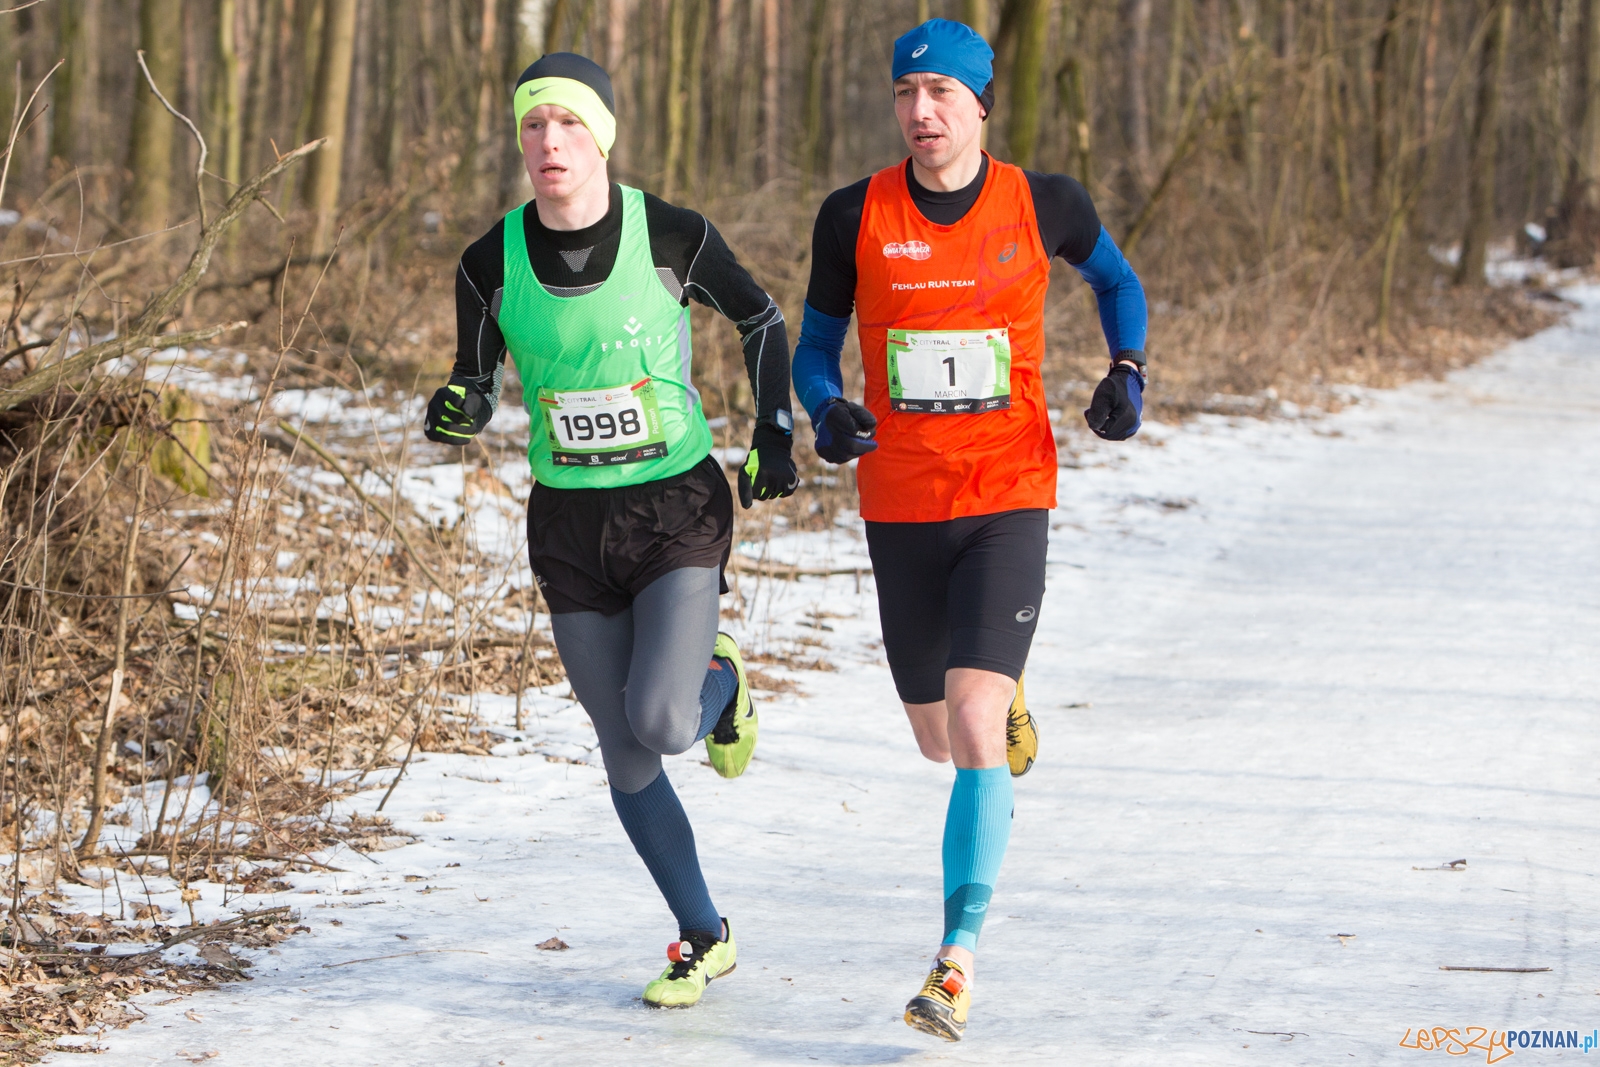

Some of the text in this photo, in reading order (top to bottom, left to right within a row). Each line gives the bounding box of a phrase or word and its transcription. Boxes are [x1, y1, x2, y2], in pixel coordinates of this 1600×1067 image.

[891, 279, 975, 291] FEHLAU RUN TEAM
[601, 335, 663, 352] FROST
[942, 356, 956, 387] 1
[934, 389, 967, 398] MARCIN
[559, 408, 641, 441] 1998
